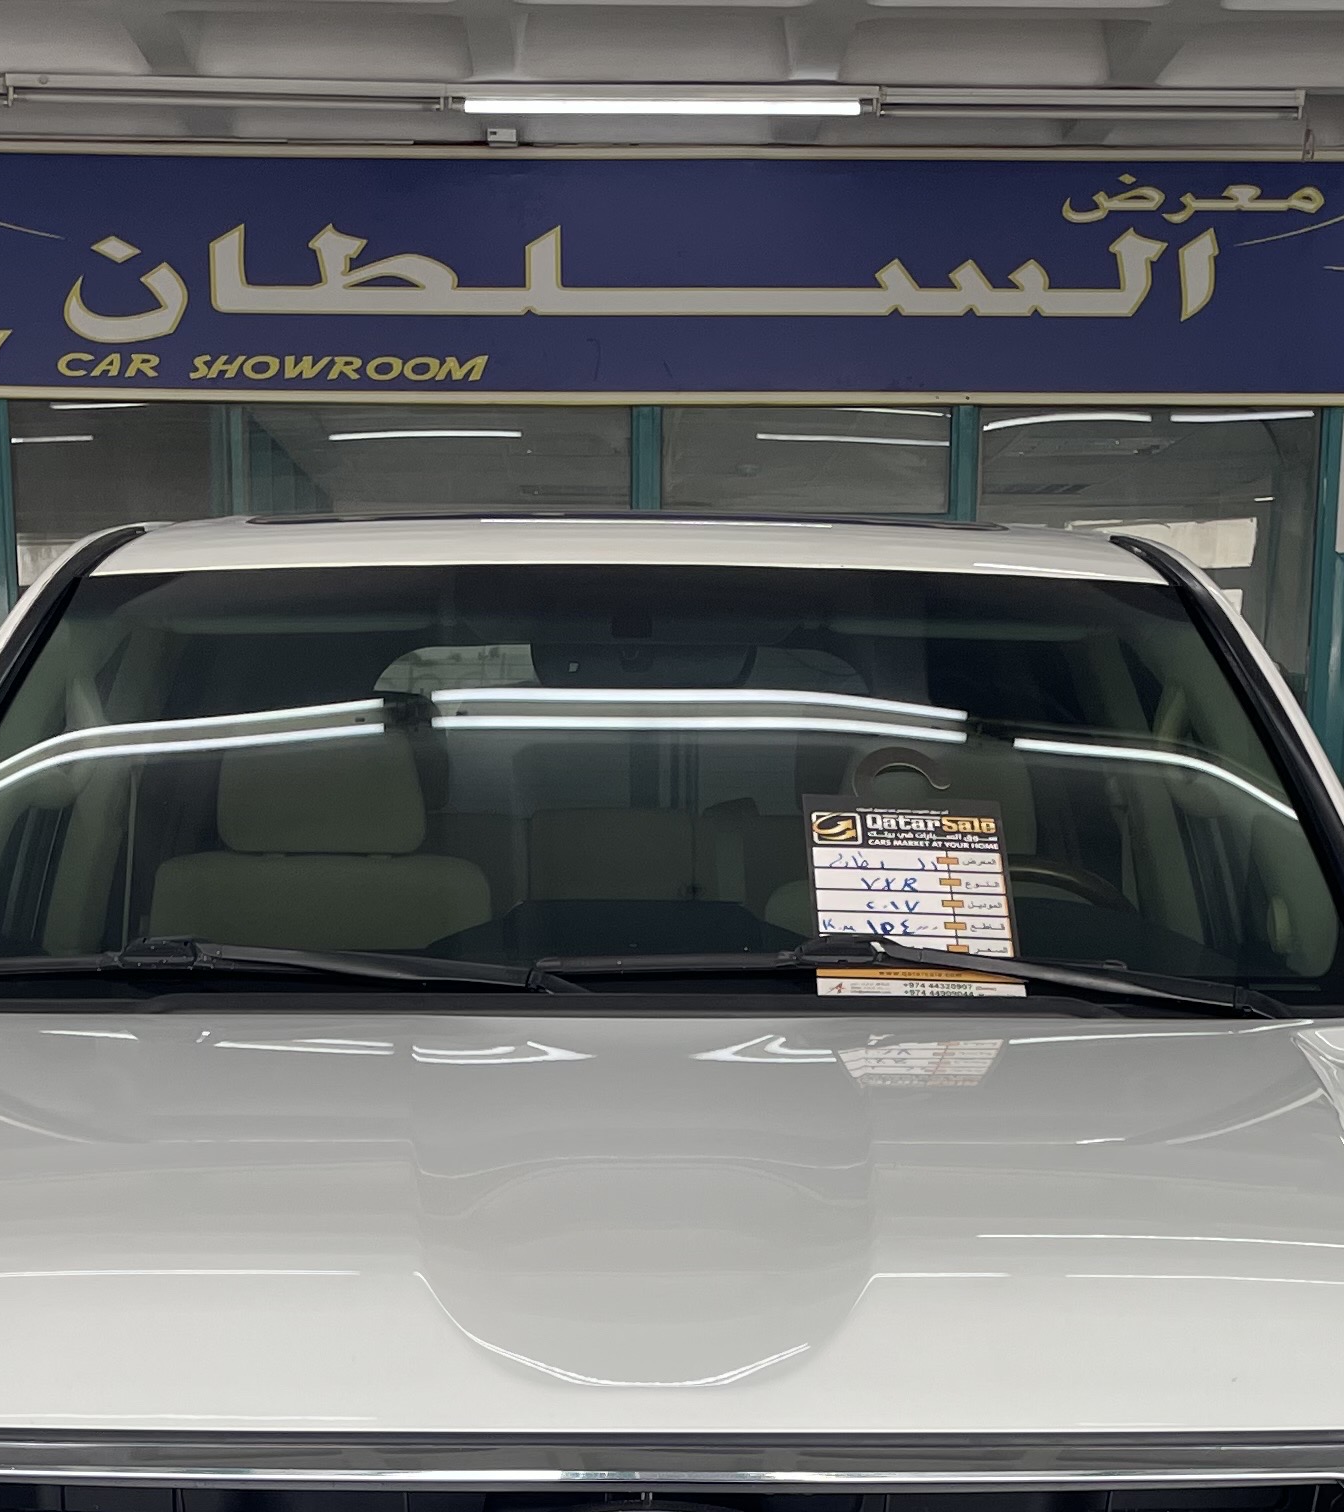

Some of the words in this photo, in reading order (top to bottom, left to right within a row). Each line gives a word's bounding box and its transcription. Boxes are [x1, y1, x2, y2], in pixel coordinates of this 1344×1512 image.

[1061, 174, 1326, 223] معرض
[62, 223, 1220, 343] السلطان
[56, 352, 162, 380] CAR
[188, 353, 490, 383] SHOWROOM
